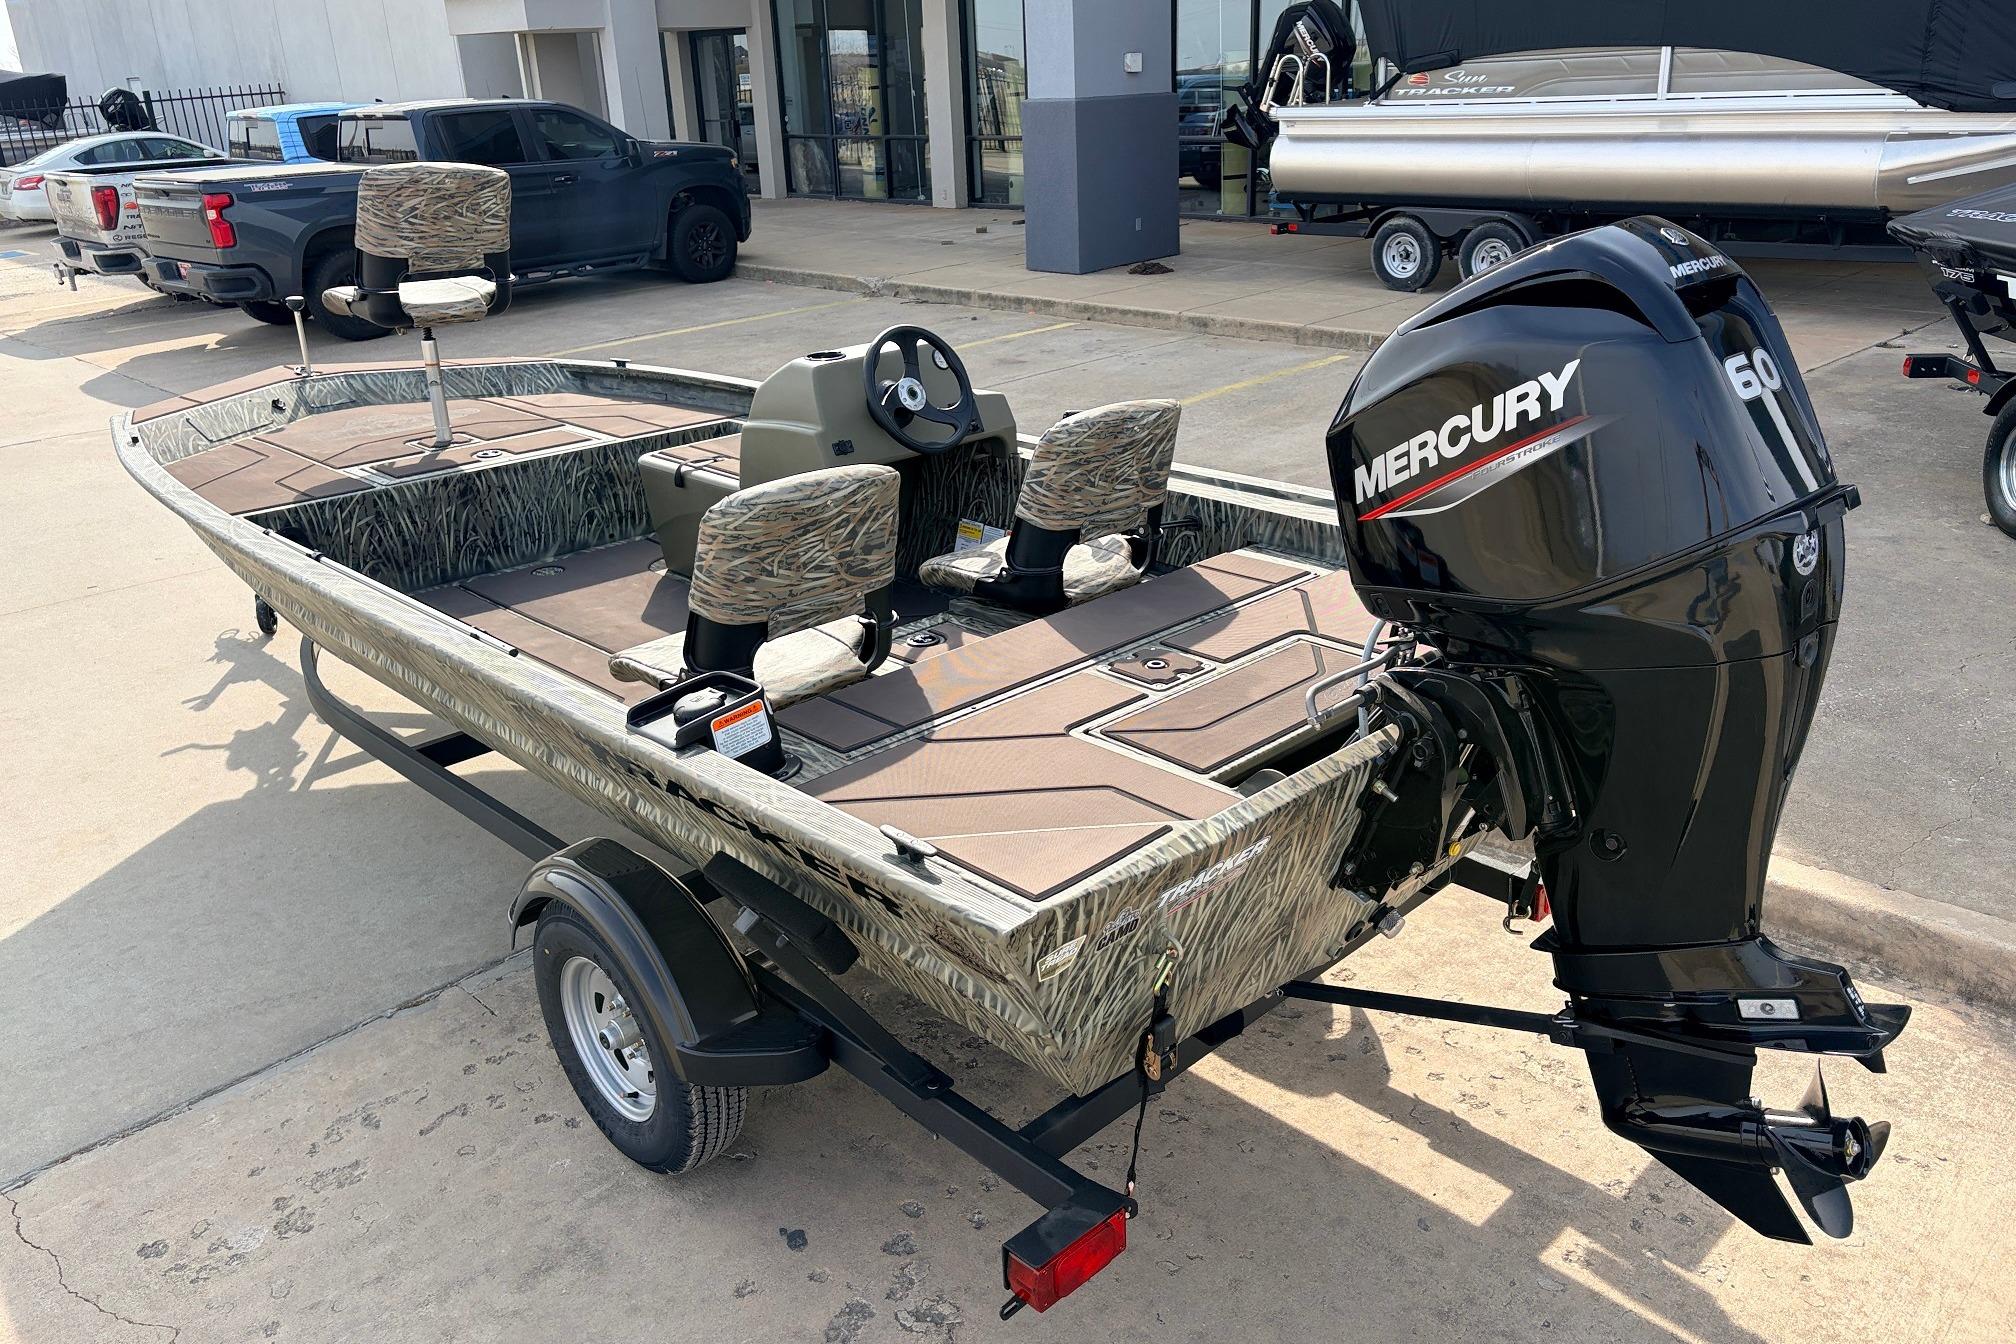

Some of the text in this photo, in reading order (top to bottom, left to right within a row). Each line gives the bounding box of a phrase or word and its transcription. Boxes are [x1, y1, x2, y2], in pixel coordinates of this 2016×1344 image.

[1394, 86, 1516, 96] TRACKER
[1437, 70, 1488, 84] Sun
[1669, 255, 1727, 279] MERCURY
[1940, 266, 1975, 283] 175
[1723, 347, 1782, 402] 60
[1354, 358, 1581, 505] MERCURY
[1470, 433, 1561, 480] FOURSTROKE
[723, 707, 753, 724] WARNING
[576, 731, 905, 920] TRACKER
[1157, 835, 1272, 910] TRACKER
[1095, 918, 1140, 952] CAMO
